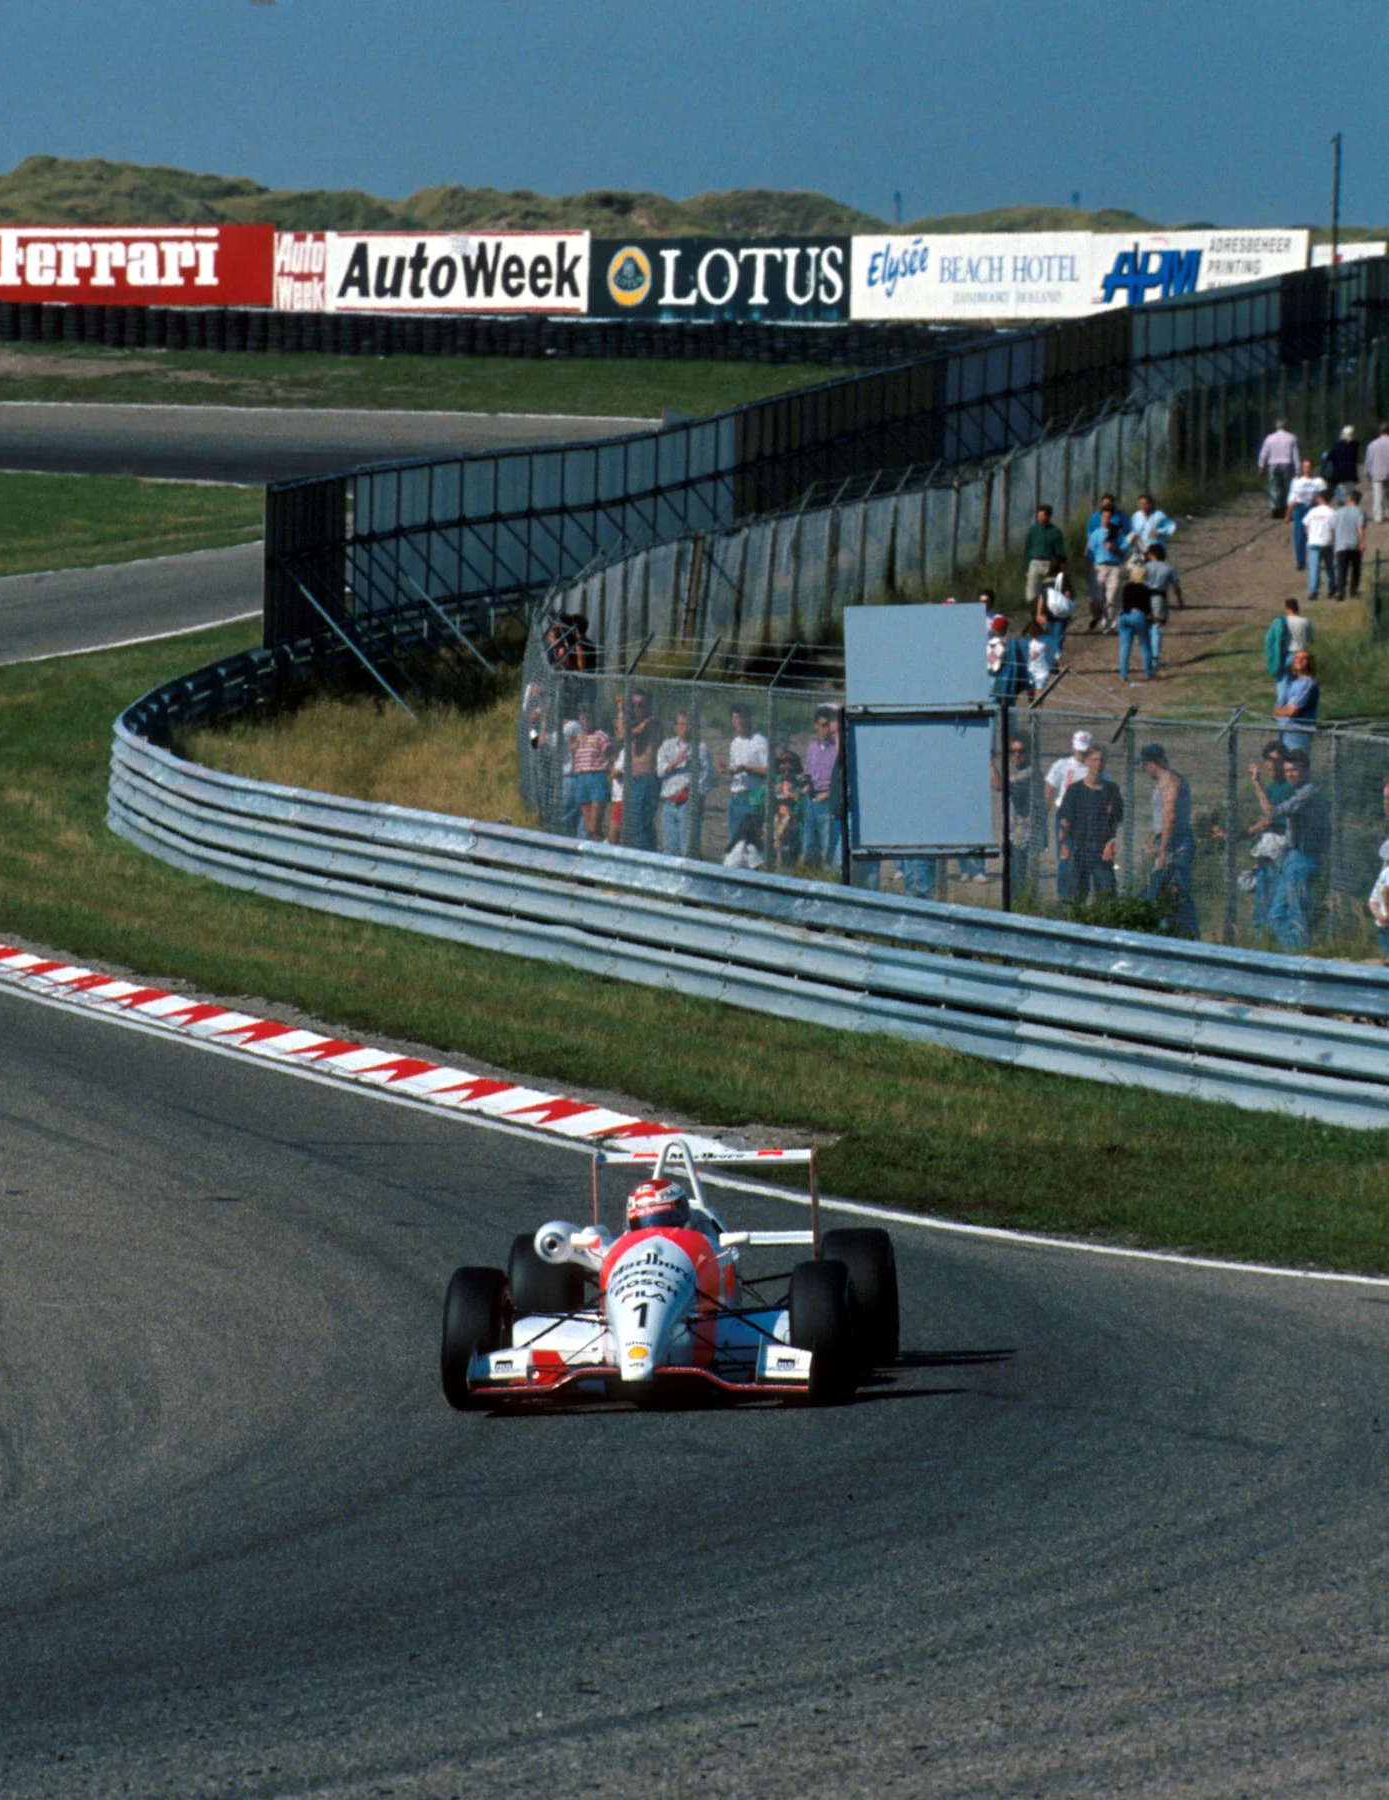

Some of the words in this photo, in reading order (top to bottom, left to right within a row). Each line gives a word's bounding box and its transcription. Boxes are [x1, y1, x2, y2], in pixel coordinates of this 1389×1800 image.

[274, 232, 325, 273] Auto
[867, 238, 929, 298] Elysée
[1207, 259, 1262, 275] PRINTING
[337, 241, 583, 299] AutoWeek
[658, 246, 844, 305] LOTUS
[939, 256, 1004, 284] BEACH
[1011, 255, 1080, 283] HOTEL
[274, 275, 325, 310] Week
[612, 1252, 693, 1284] Marlboro
[615, 1279, 678, 1297] BOSCH
[621, 1290, 666, 1303] FILA
[632, 1302, 648, 1328] 1
